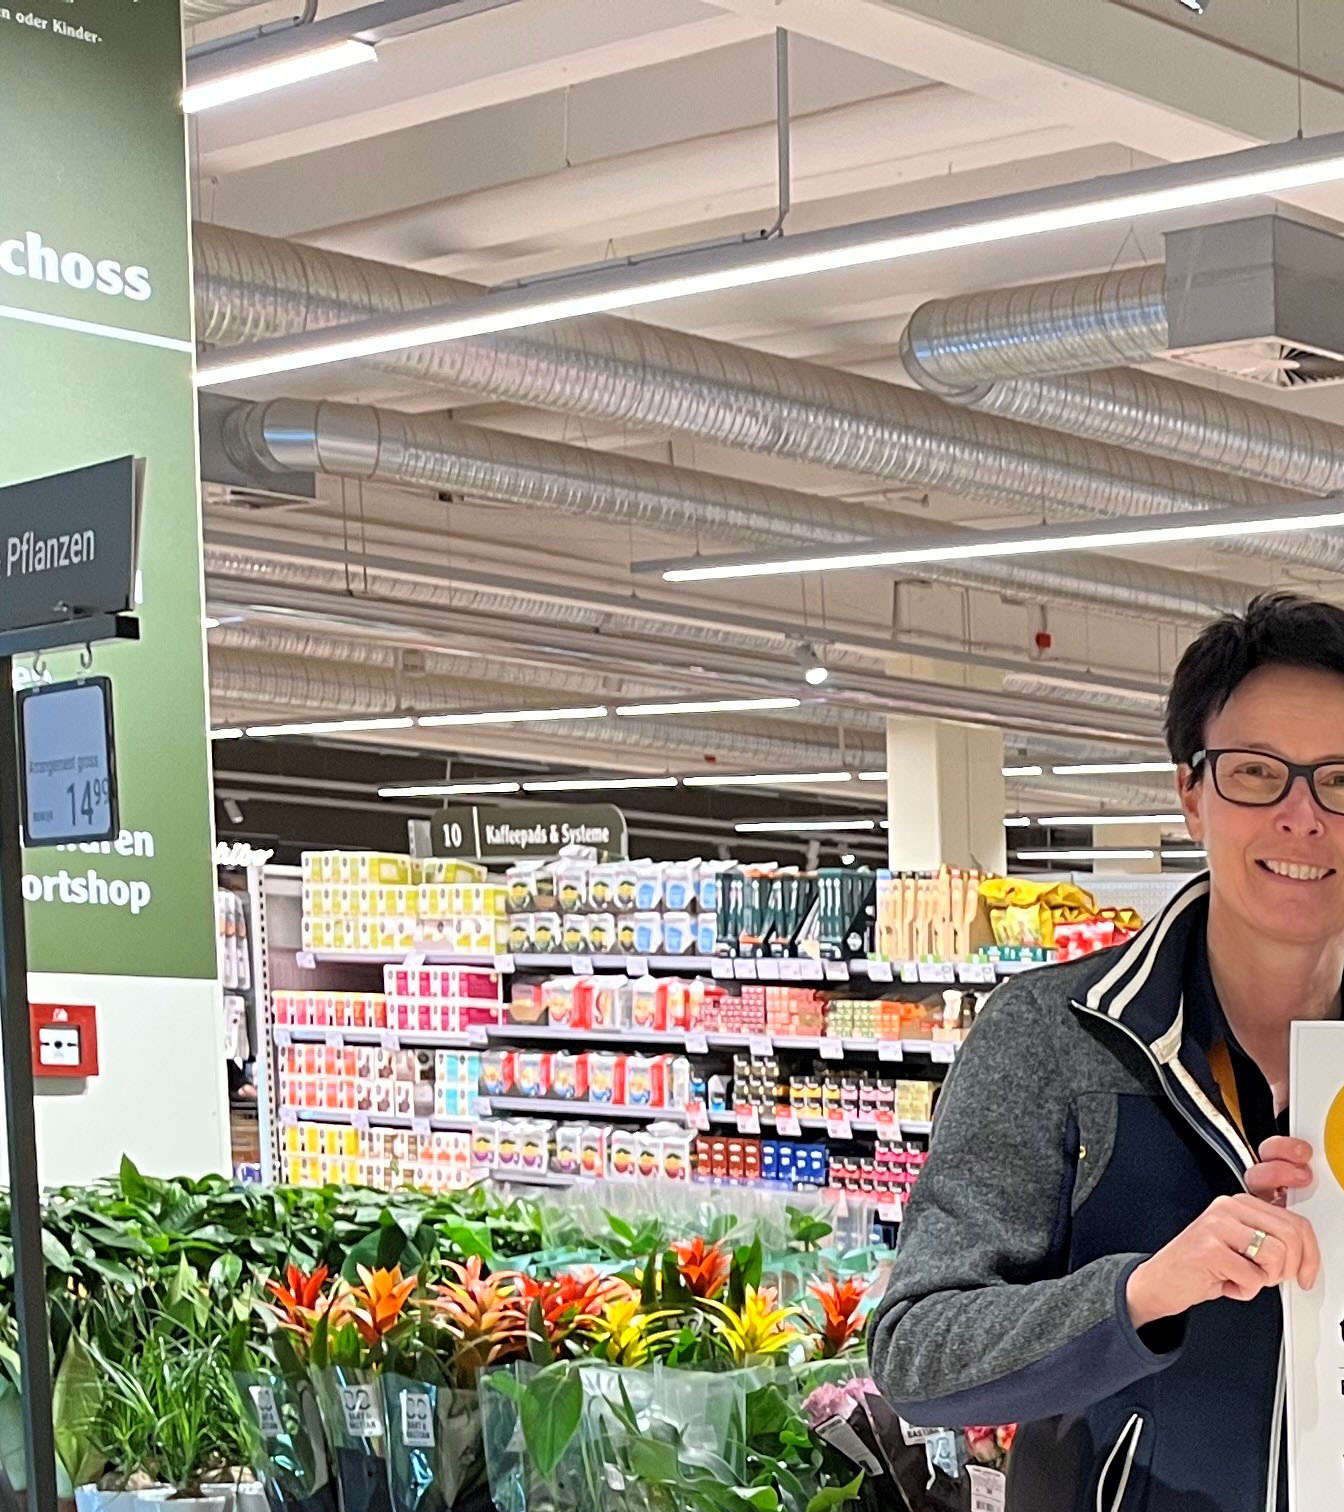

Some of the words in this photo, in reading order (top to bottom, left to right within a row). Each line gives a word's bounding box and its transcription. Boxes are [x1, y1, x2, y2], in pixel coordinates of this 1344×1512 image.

[15, 12, 48, 30] oder
[52, 18, 103, 43] Kinder-
[0, 231, 152, 301] choss
[6, 525, 96, 577] Pflanzen
[442, 822, 463, 848] 10
[485, 824, 548, 849] Kaffeepads
[561, 823, 610, 846] Systeme
